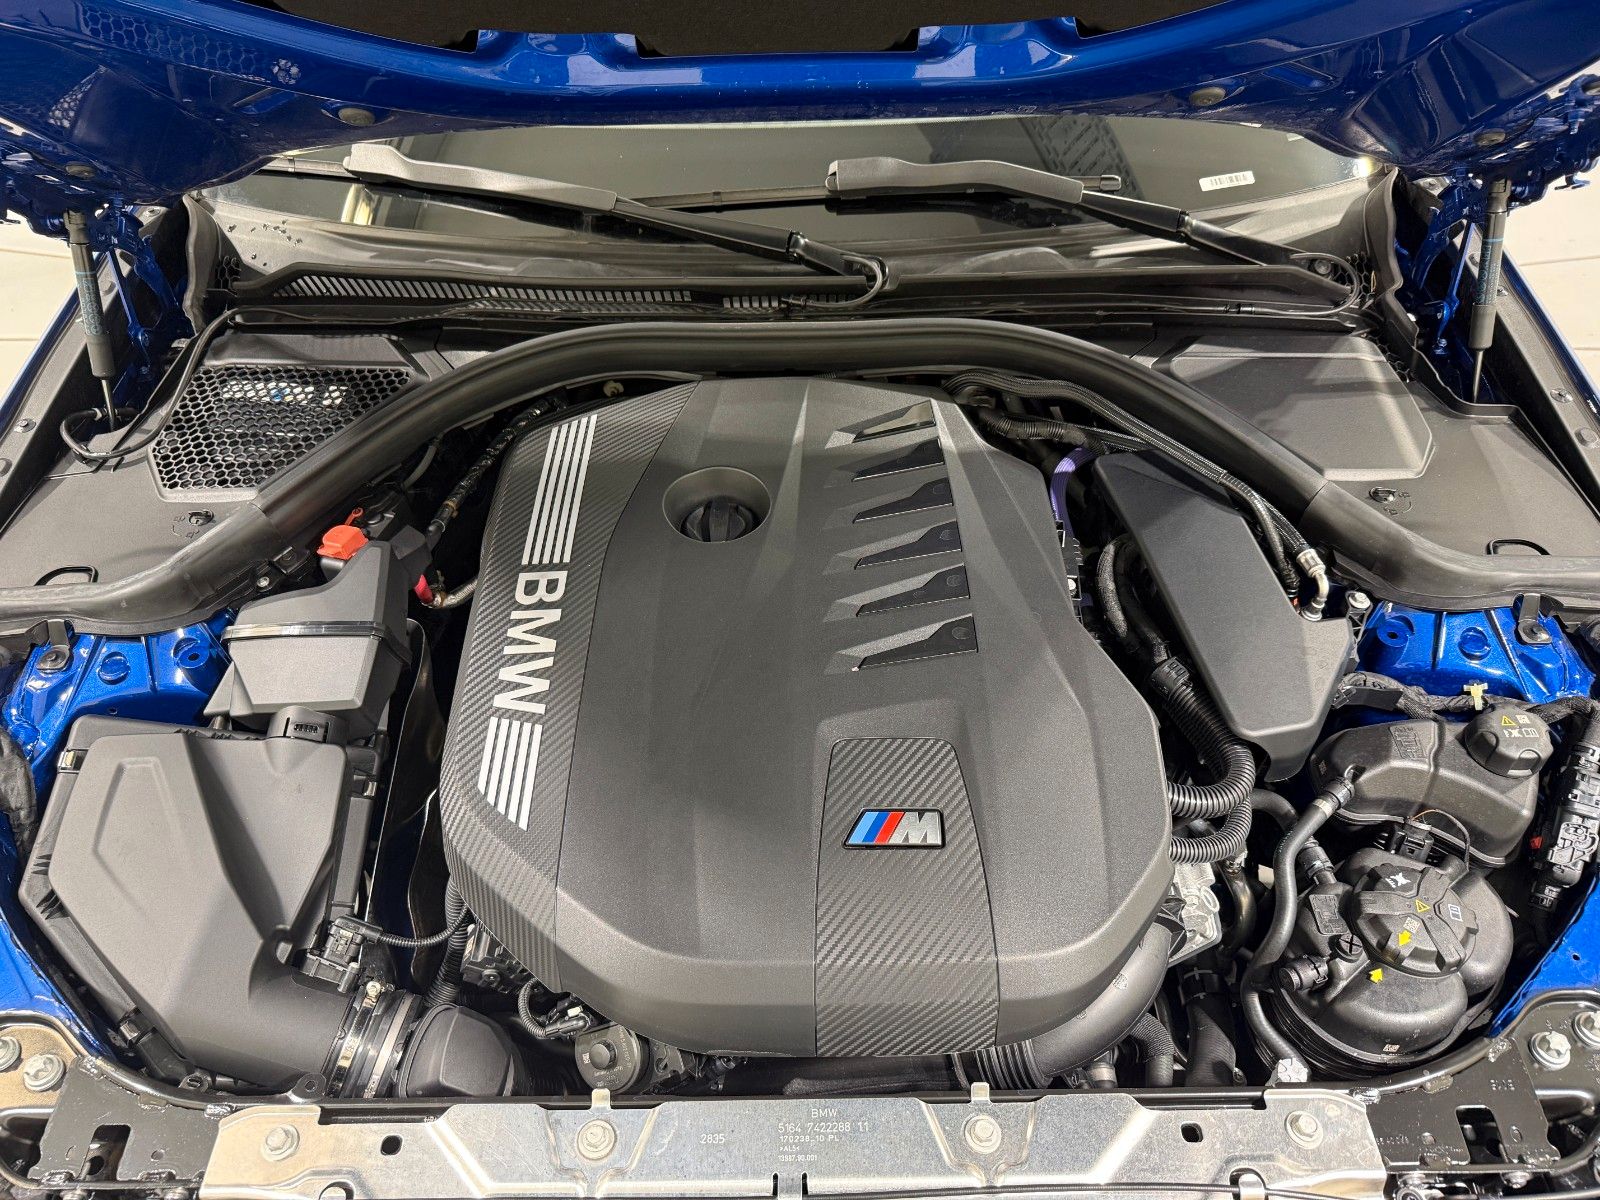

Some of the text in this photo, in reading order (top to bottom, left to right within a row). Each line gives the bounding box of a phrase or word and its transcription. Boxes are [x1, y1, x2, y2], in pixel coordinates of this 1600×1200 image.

[492, 570, 568, 715] BMW
[811, 1108, 838, 1118] BMW
[777, 1123, 801, 1133] 5164
[807, 1122, 851, 1133] 7422288
[699, 1133, 725, 1144] 2835
[828, 1134, 839, 1142] PL
